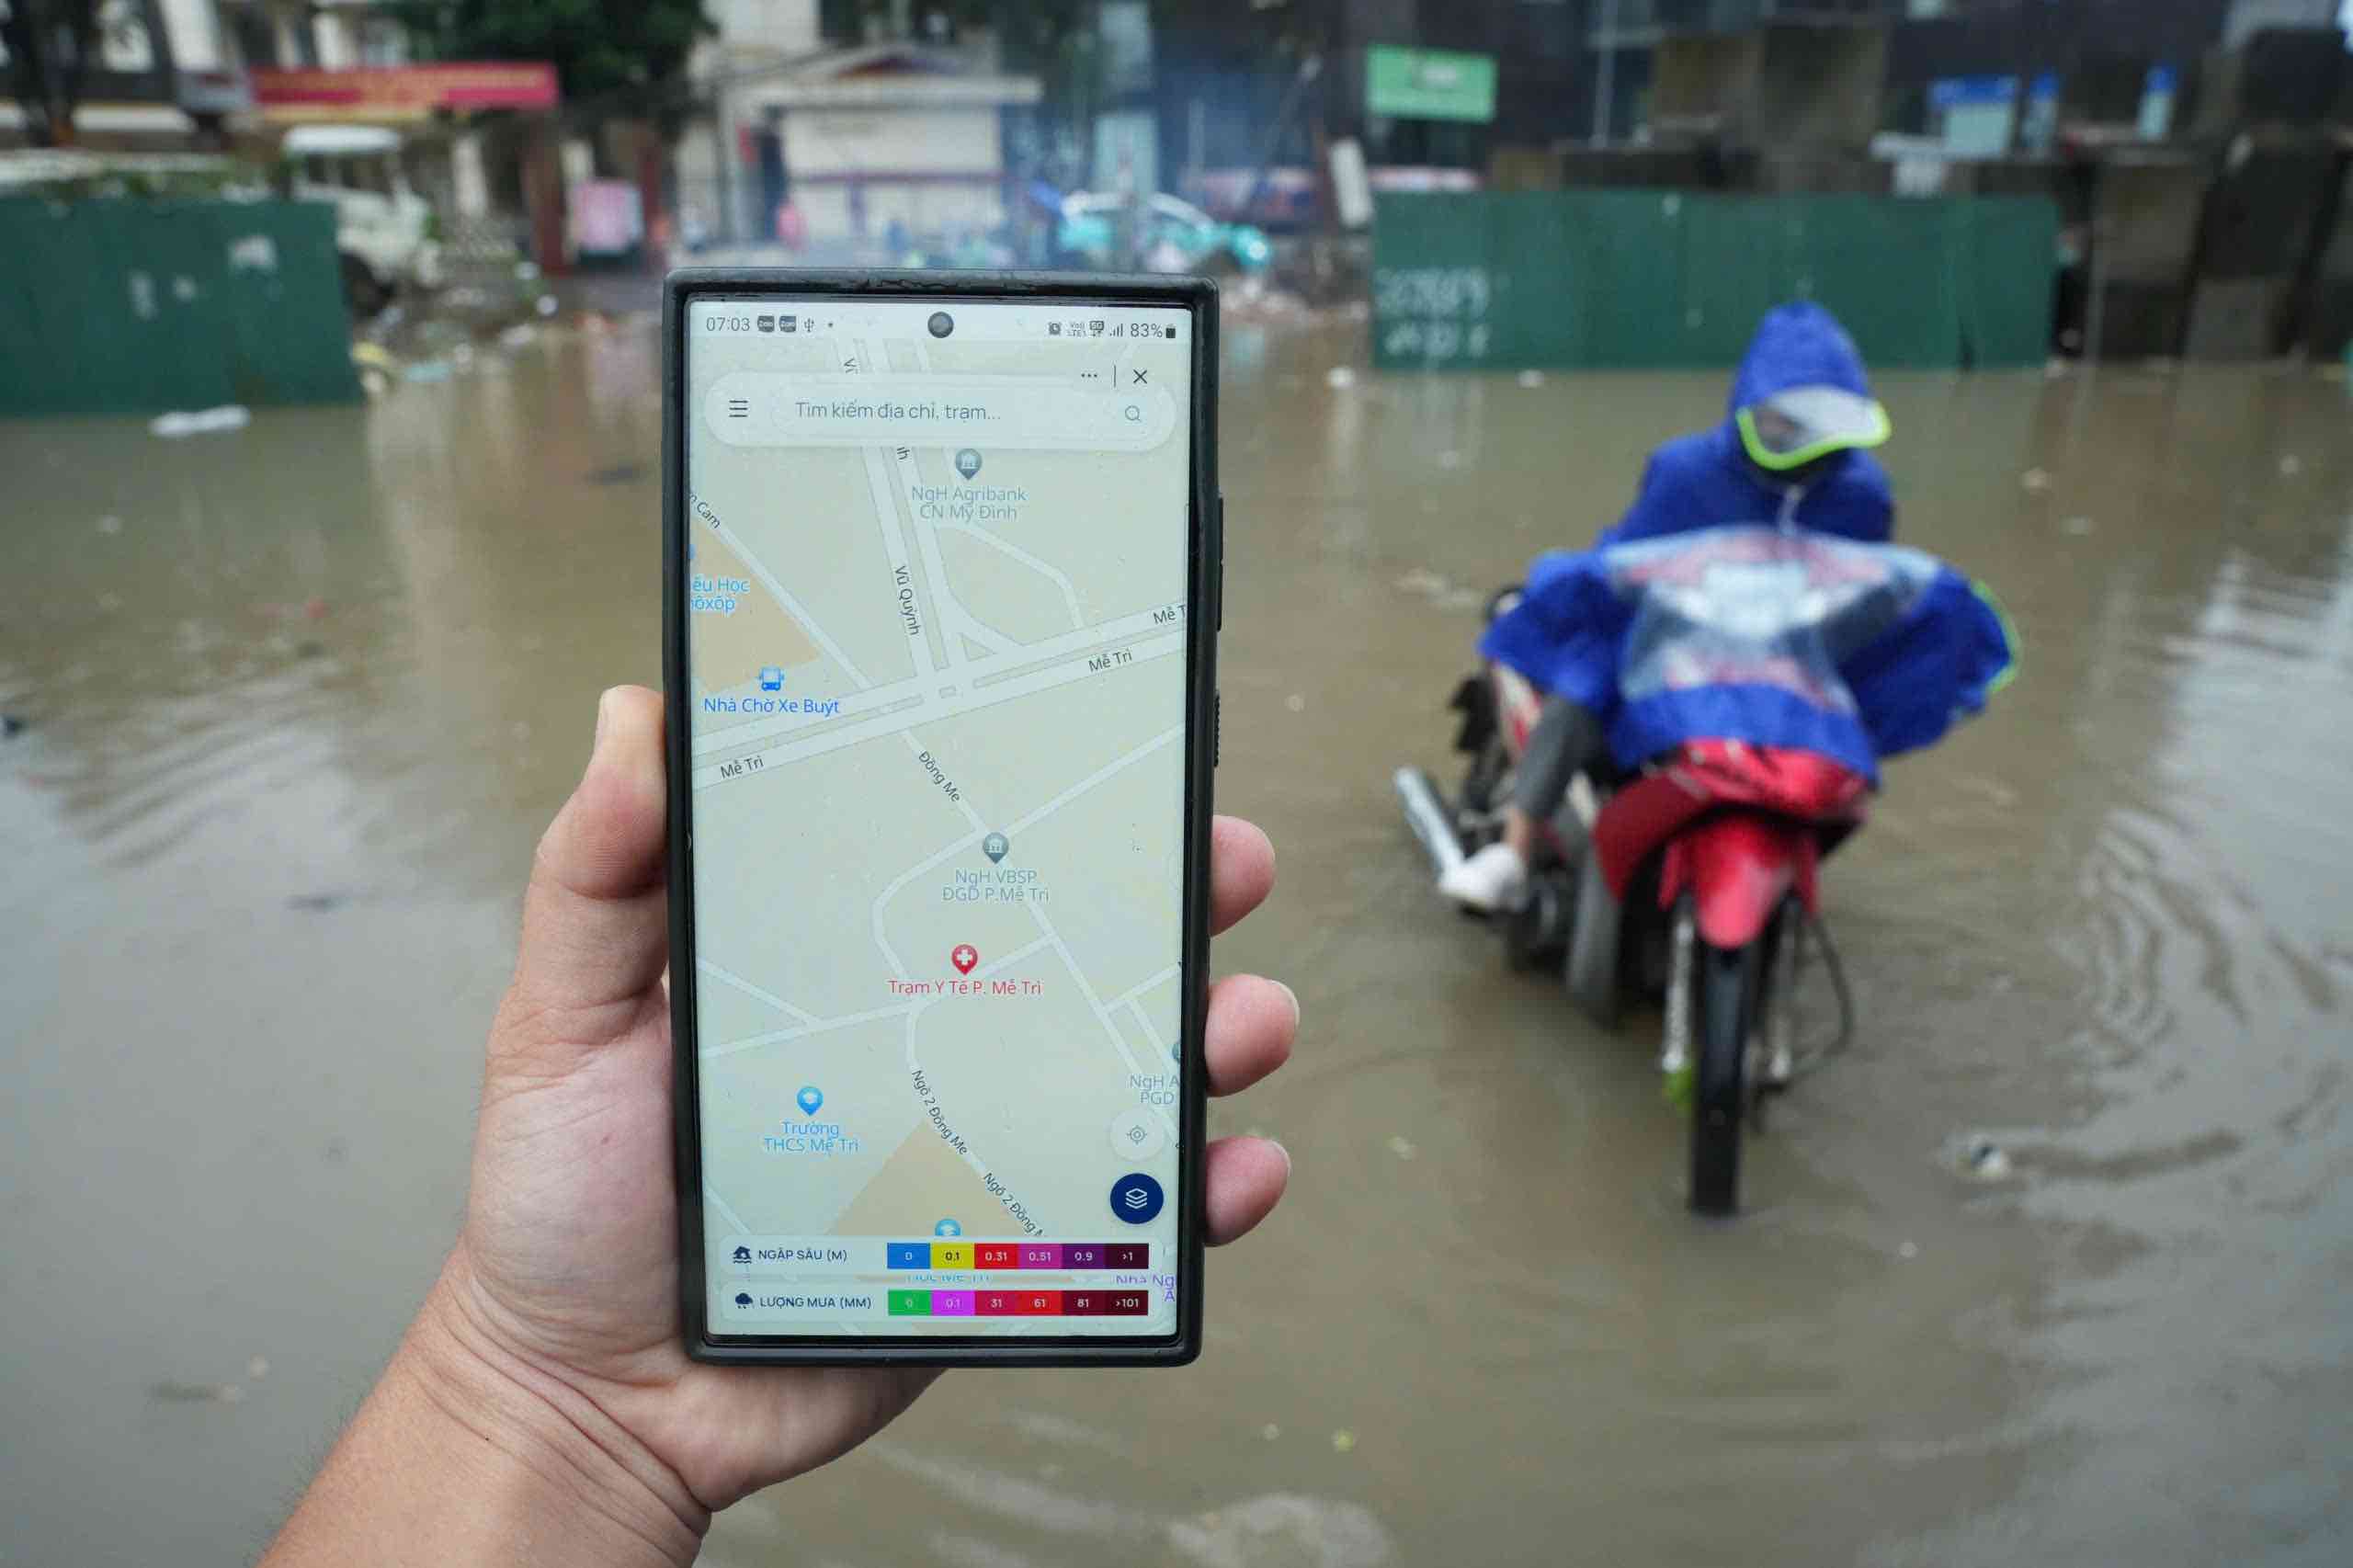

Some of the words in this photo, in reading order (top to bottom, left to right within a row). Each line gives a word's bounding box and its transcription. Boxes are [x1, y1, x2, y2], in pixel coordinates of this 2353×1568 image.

[706, 316, 751, 332] 07:03
[1130, 322, 1164, 338] 83%
[795, 401, 827, 417] Tìm
[832, 399, 872, 417] kiếm
[877, 402, 904, 422] địa
[908, 402, 939, 421] chỉ,
[912, 485, 948, 504] NgH
[952, 485, 1029, 506] Agribank
[697, 501, 721, 528] Cam
[920, 504, 944, 519] CN
[717, 577, 750, 596] Học
[779, 699, 799, 712] Xe
[803, 699, 840, 718] Buýt
[942, 781, 961, 802] Me
[955, 869, 990, 886] NgH
[995, 869, 1037, 883] VBSP
[888, 979, 930, 996] Trạm
[934, 979, 945, 994] Y
[972, 980, 986, 994] P.
[1130, 1074, 1165, 1091] NgH
[1139, 1090, 1176, 1106] PGD
[781, 1119, 839, 1139] Trường
[924, 1096, 936, 1106] 2
[949, 1136, 968, 1155] Me
[764, 1138, 805, 1153] THCS
[1002, 1194, 1014, 1206] 2
[797, 1246, 823, 1260] SÂU
[826, 1248, 847, 1263] (M)
[904, 1252, 913, 1261] 0
[946, 1252, 961, 1261] 0.1
[984, 1252, 1007, 1262] 0.31
[1029, 1252, 1051, 1262] 0.51
[1074, 1252, 1093, 1262] 0.9
[807, 1295, 835, 1308] MƯA
[839, 1296, 872, 1310] (MM)
[945, 1299, 961, 1308] 0.1
[990, 1299, 1003, 1308] 31
[1033, 1299, 1046, 1308] 61
[1077, 1299, 1090, 1309] 81
